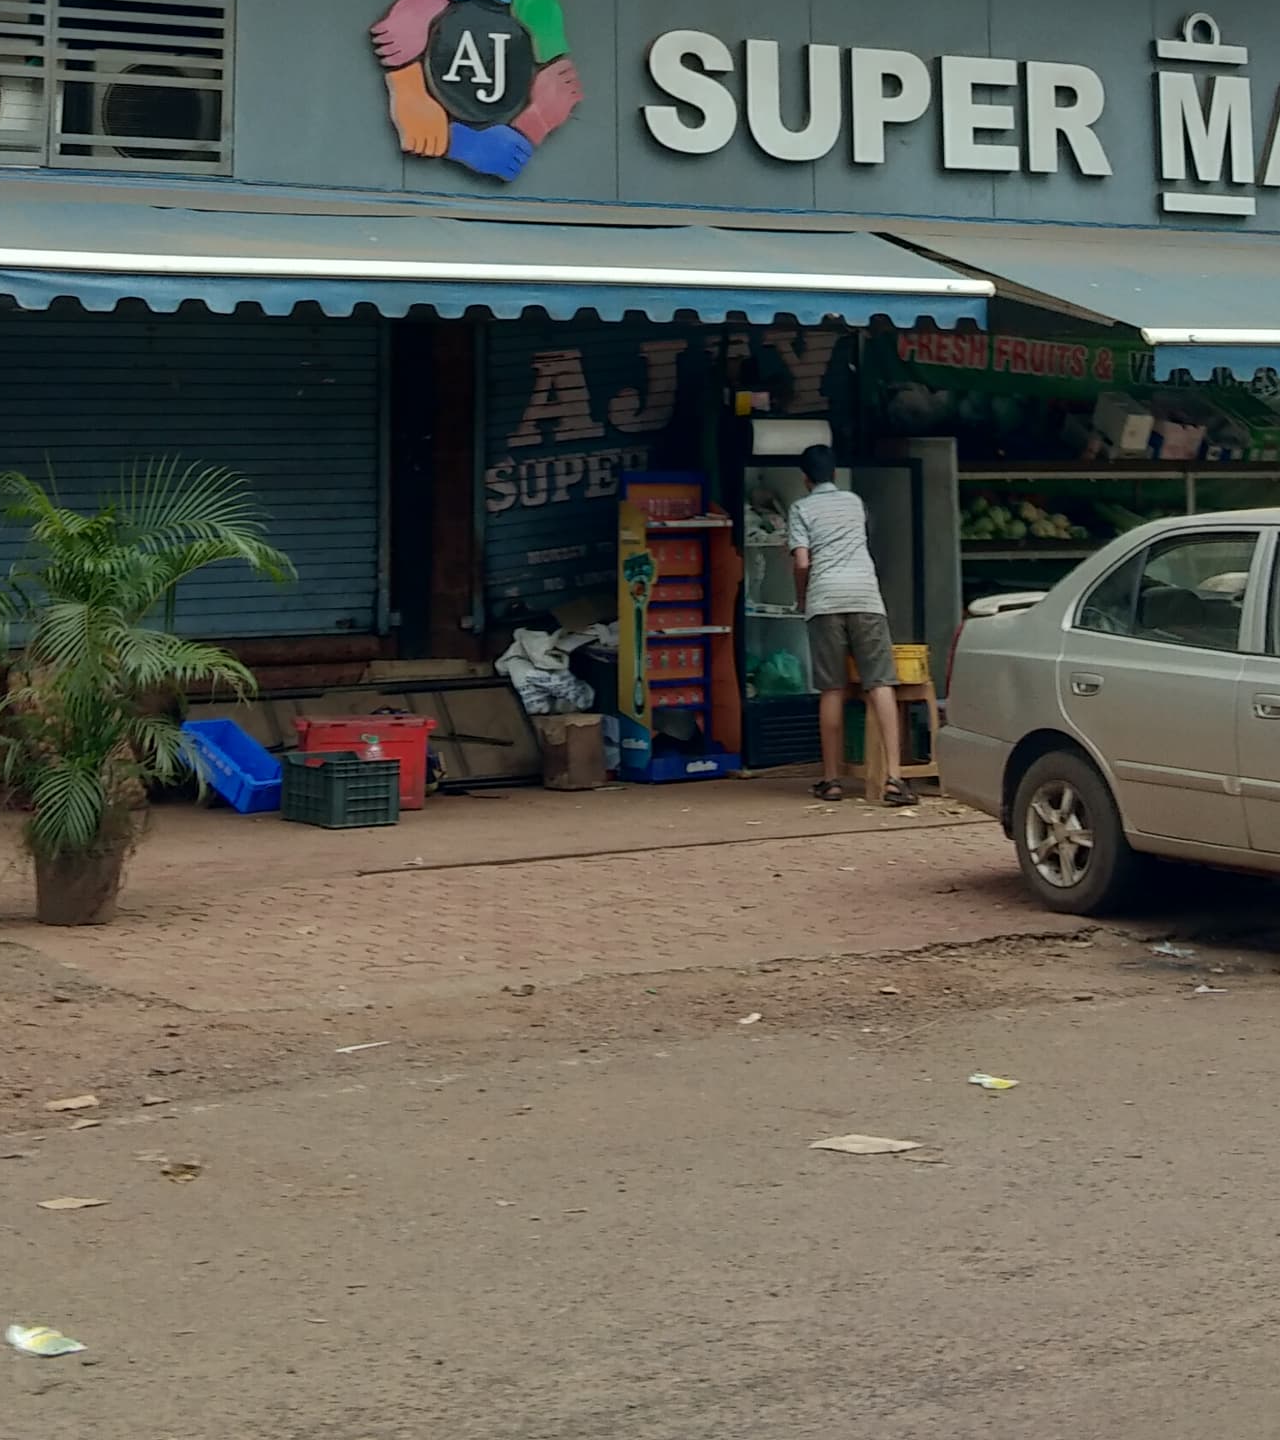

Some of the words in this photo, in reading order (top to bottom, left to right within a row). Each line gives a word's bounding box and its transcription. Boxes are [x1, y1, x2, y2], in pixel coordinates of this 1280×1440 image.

[441, 29, 512, 104] AJ
[641, 29, 1113, 176] SUPER
[898, 331, 985, 370] FRESH
[993, 335, 1087, 378] FRUITS
[1093, 346, 1114, 380] &
